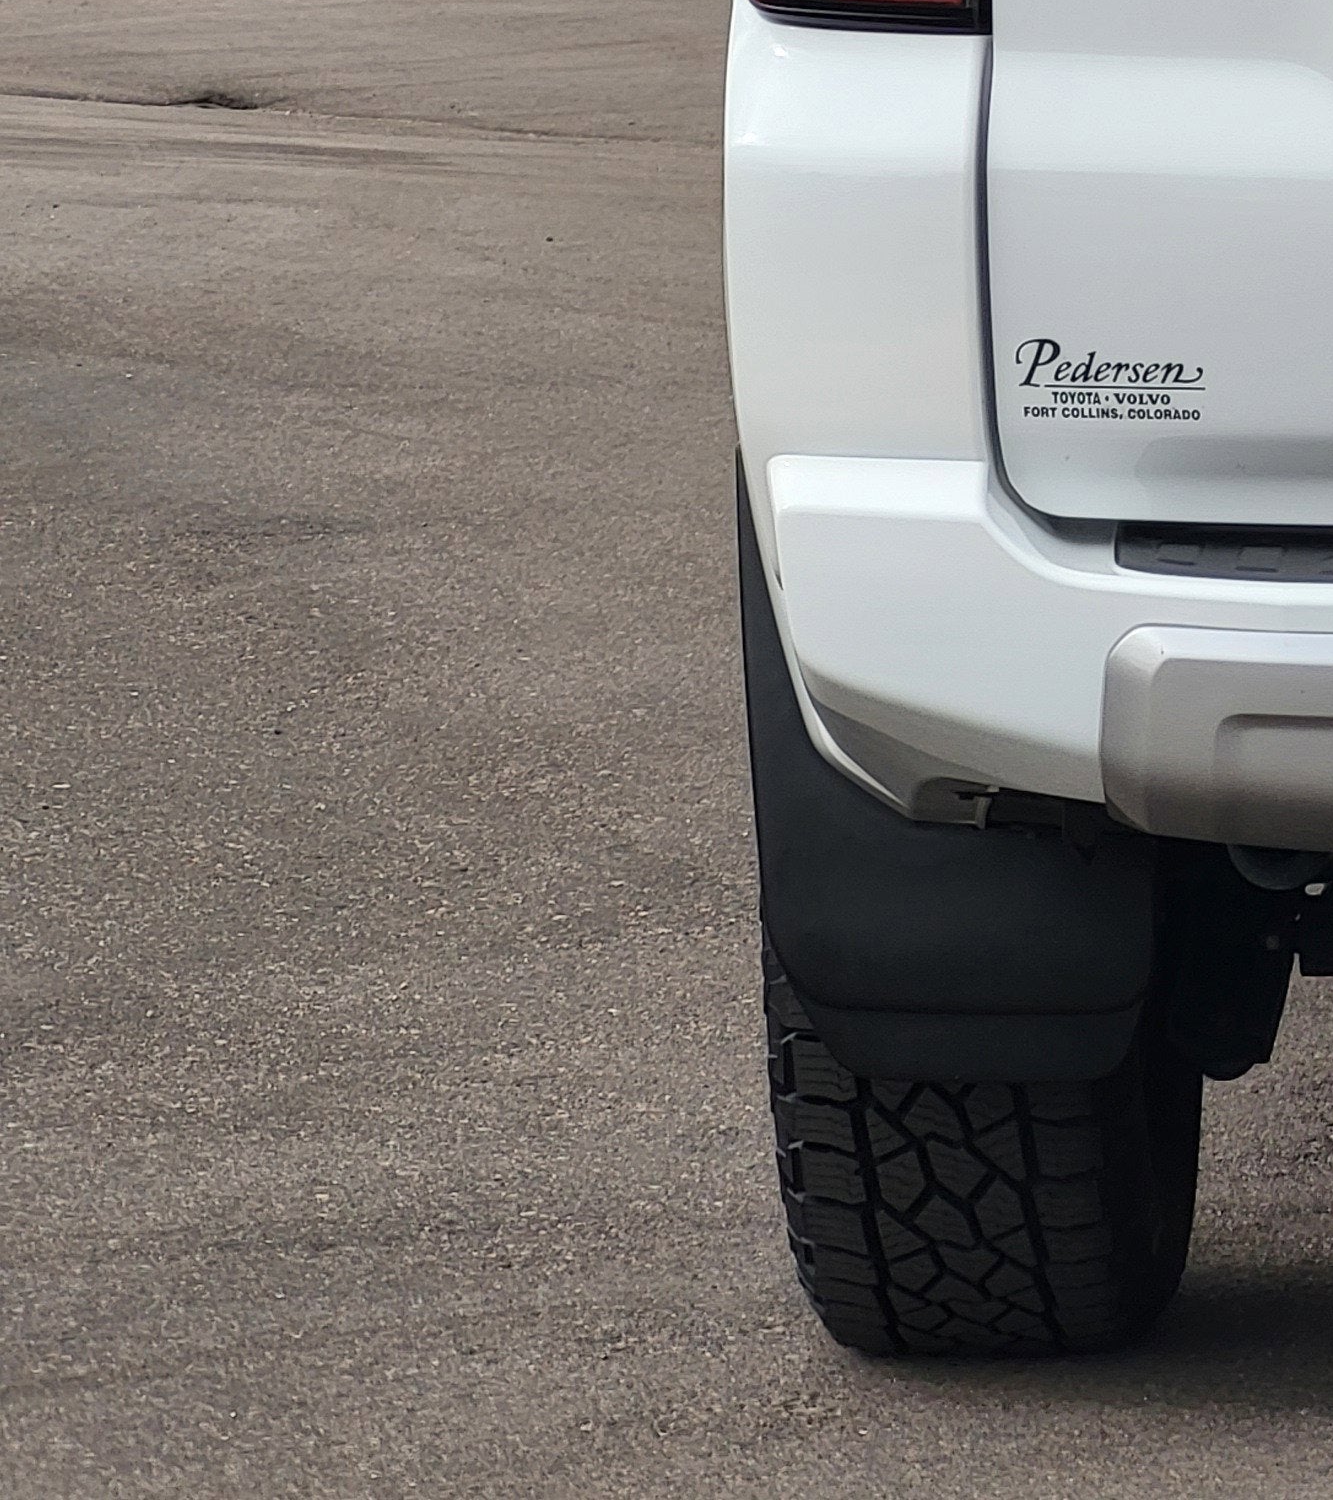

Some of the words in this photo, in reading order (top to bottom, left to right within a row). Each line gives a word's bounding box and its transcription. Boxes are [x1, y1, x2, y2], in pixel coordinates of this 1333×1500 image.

[1015, 338, 1204, 388] Pedersen
[1051, 391, 1102, 405] TOYOTA
[1113, 392, 1171, 406] VOLVO
[1023, 406, 1058, 418] FORT
[1061, 407, 1123, 420] COLLINS,
[1127, 408, 1201, 421] COLORADO
